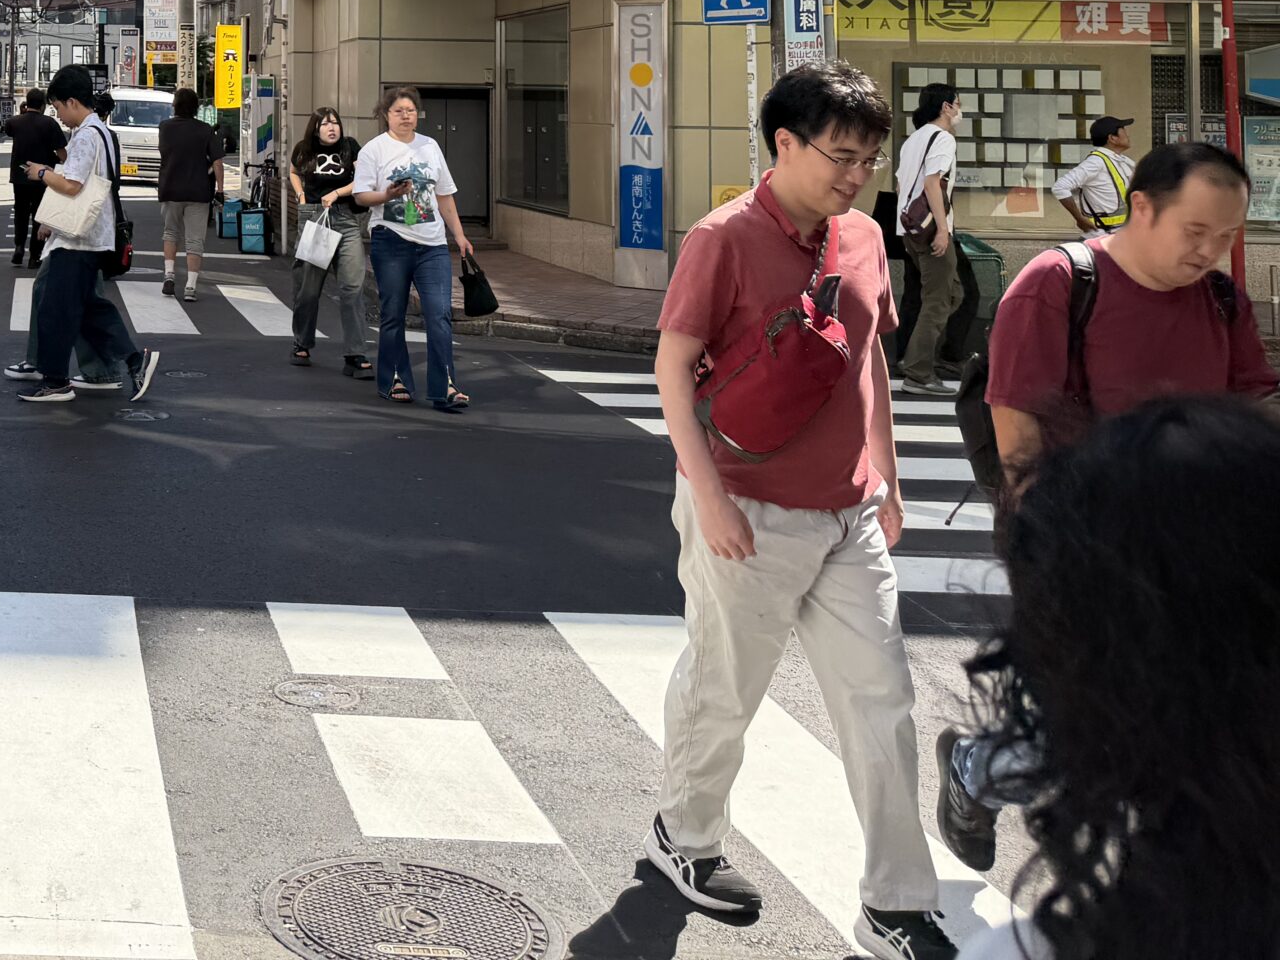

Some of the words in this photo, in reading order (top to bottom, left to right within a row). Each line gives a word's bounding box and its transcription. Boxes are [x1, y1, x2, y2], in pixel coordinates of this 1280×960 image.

[631, 174, 644, 244] 湘南しんきん
